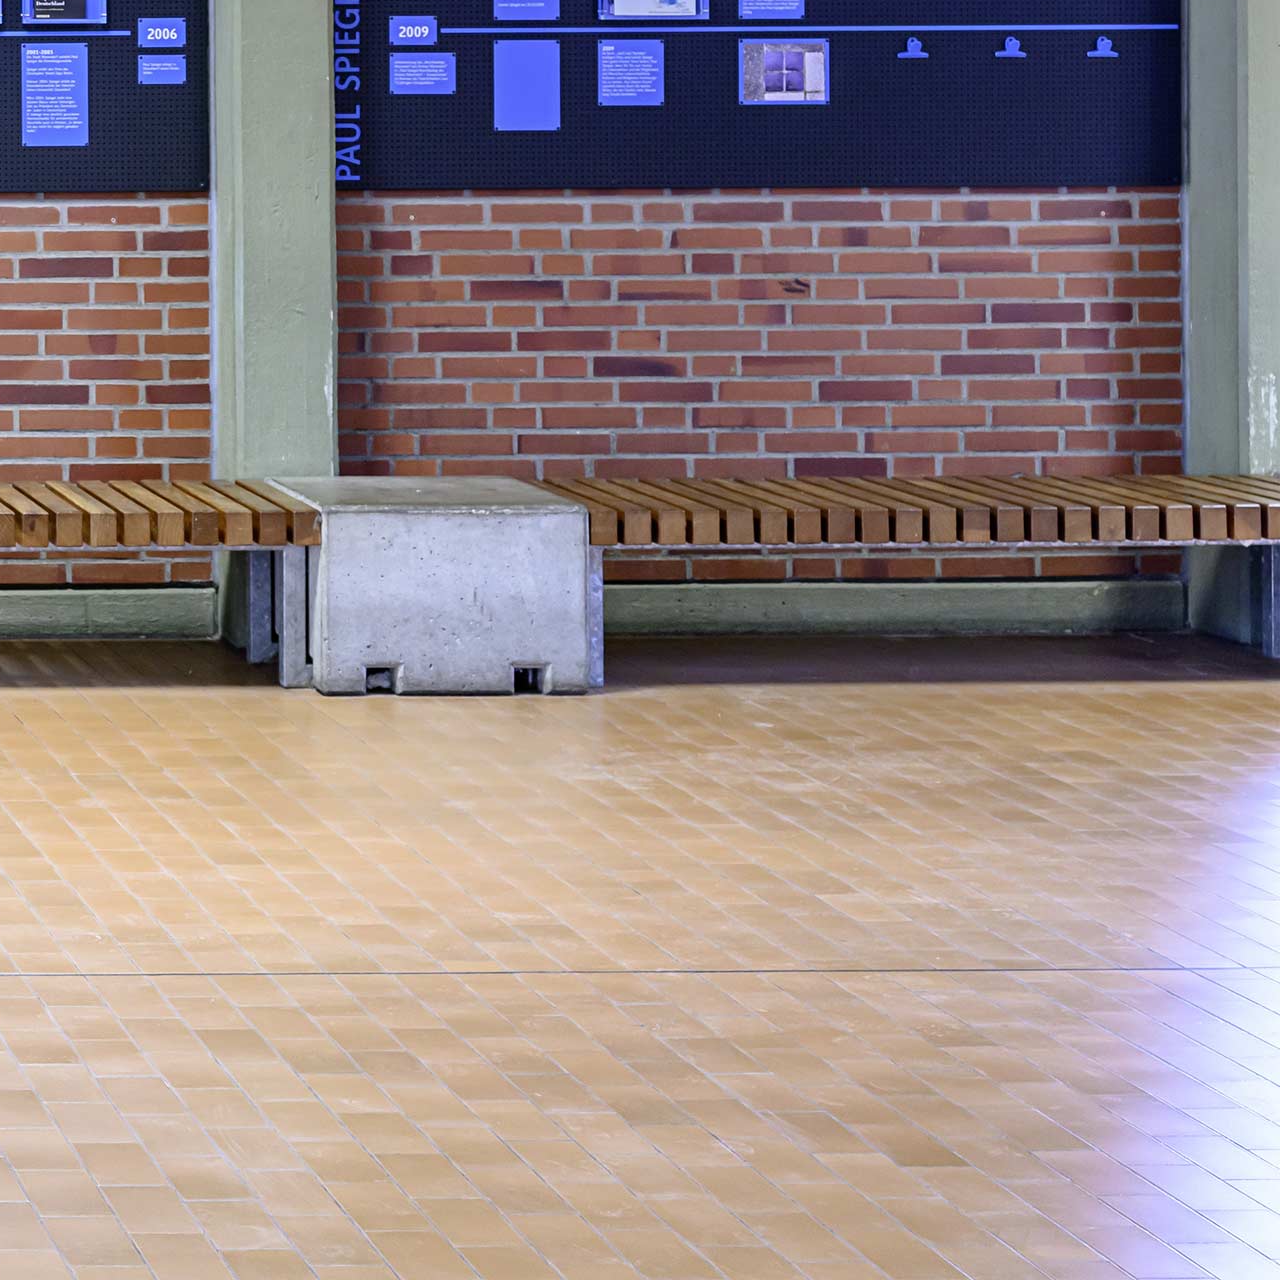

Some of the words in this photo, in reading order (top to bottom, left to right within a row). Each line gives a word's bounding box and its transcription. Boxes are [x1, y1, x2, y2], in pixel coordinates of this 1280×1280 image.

[147, 27, 178, 40] 2006
[399, 25, 429, 38] 2009
[335, 104, 362, 181] PAUL
